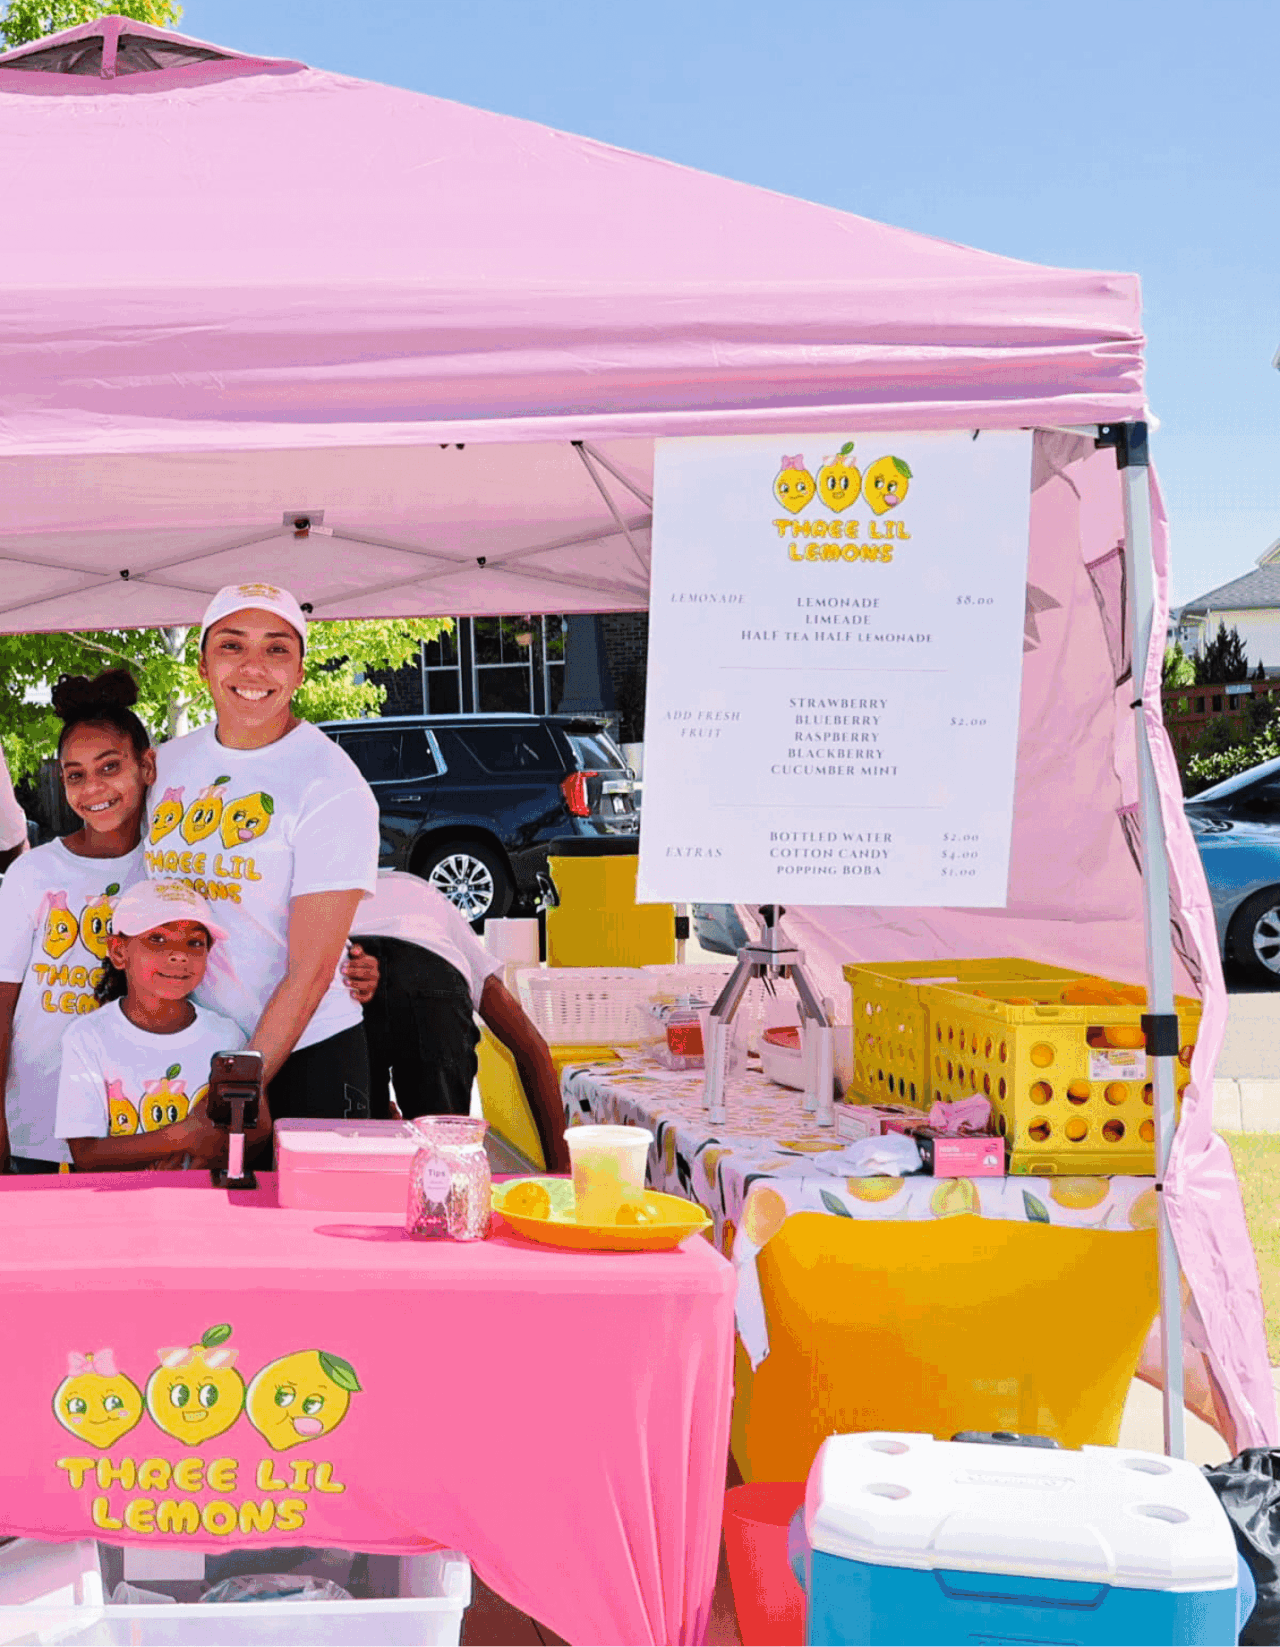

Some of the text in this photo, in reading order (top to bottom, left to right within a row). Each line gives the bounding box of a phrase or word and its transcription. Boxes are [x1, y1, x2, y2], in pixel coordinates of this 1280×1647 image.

[772, 519, 912, 540] THREE LIL
[788, 542, 894, 563] LEMONS
[671, 593, 746, 604] LEMONADE
[797, 597, 880, 608] LEMONADE
[806, 614, 871, 625] LIMEADE
[741, 630, 933, 643] HALF TEA HALF LEMONADE
[789, 698, 888, 709] STRAWBERRY
[665, 710, 741, 721] ADD FRESH
[795, 714, 881, 726] BLUEBERRY
[950, 716, 987, 726] $2.00
[680, 727, 722, 738] FRUIT
[795, 731, 879, 742] RASPBERRY
[788, 748, 884, 759] BLACKBERRY
[771, 764, 898, 776] CUCUMBER MINT
[770, 831, 892, 843] BOTTLED WATER
[665, 846, 723, 857] EXTRAS
[770, 848, 889, 859] COTTON CANDY
[213, 853, 262, 881] LIL
[777, 865, 881, 875] POPPING BOBA
[32, 963, 106, 989] THRE
[428, 1168, 446, 1178] Tips
[55, 1456, 346, 1494] THREE LIL
[91, 1496, 308, 1537] LEMONS
